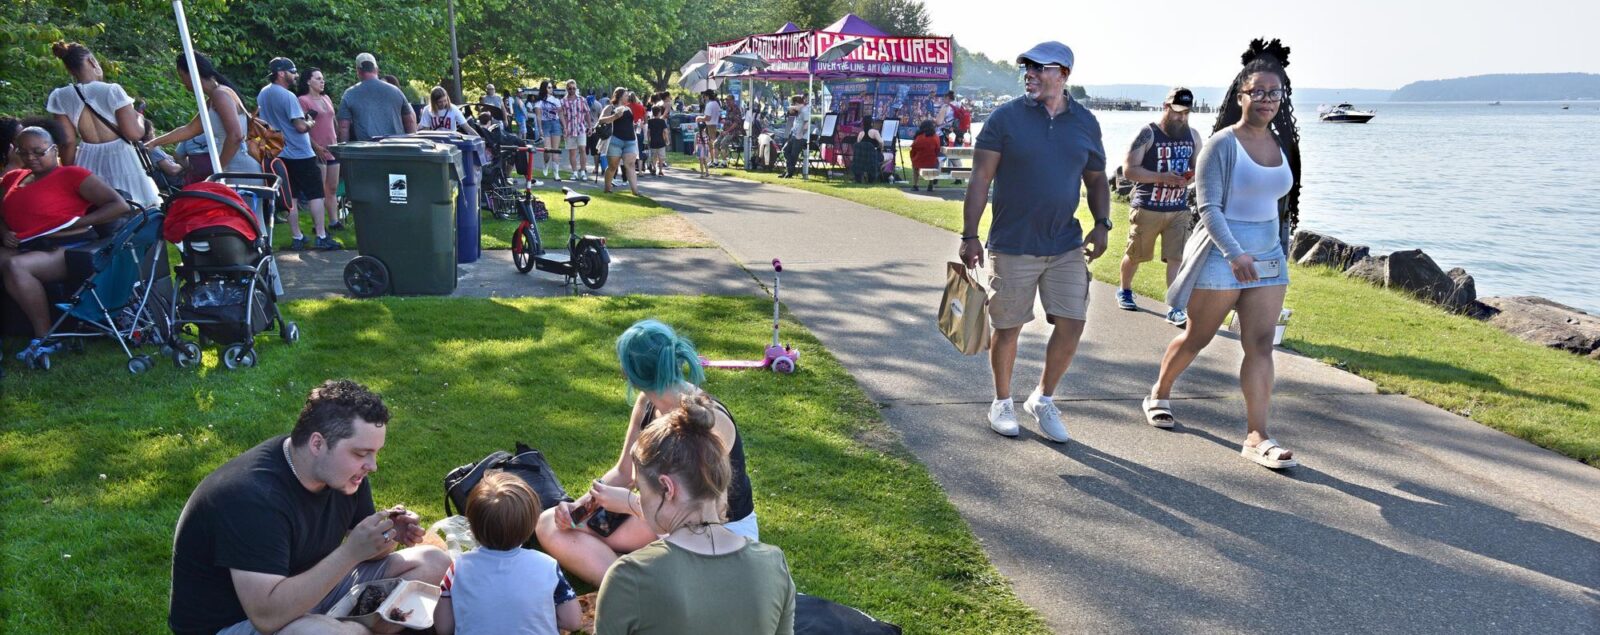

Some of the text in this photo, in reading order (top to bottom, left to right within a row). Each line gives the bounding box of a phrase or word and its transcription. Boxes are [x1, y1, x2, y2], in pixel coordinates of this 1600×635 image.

[817, 32, 948, 63] CICATURES
[817, 62, 836, 71] OVER
[850, 63, 865, 72] LINE
[867, 64, 881, 73] ART
[1157, 145, 1192, 158] DO YOU
